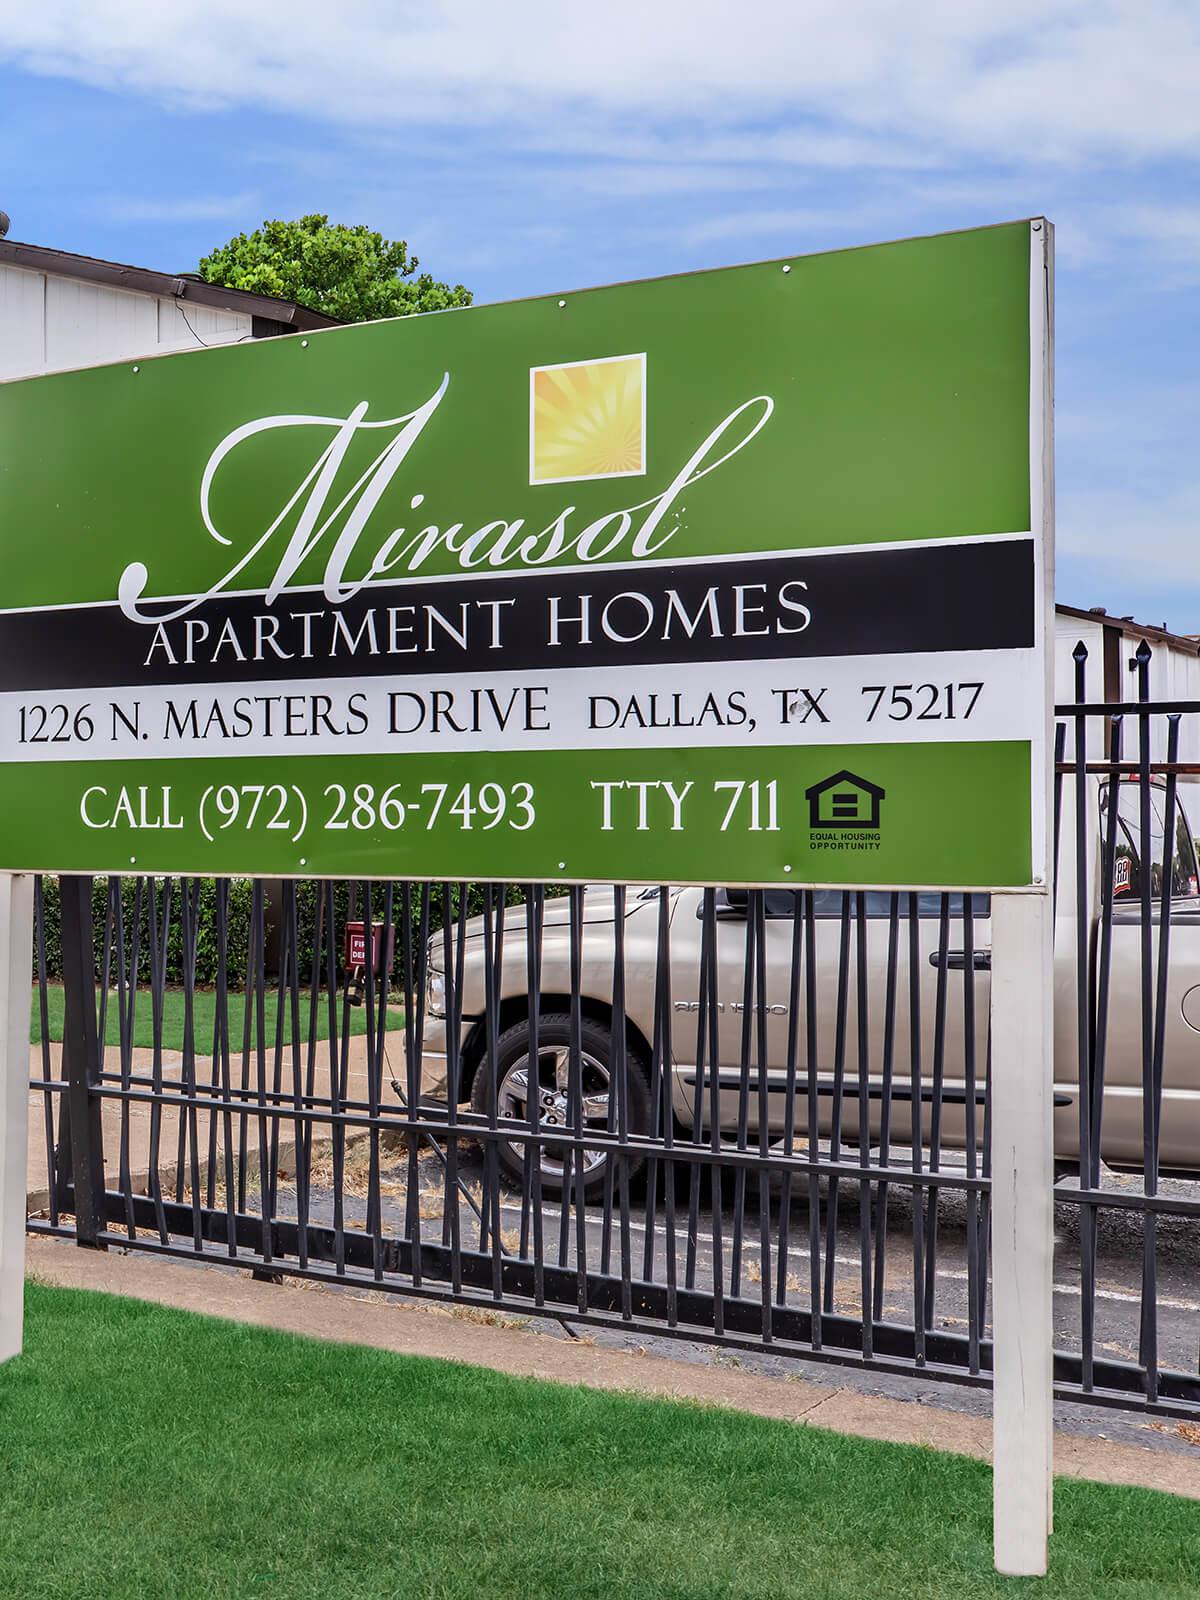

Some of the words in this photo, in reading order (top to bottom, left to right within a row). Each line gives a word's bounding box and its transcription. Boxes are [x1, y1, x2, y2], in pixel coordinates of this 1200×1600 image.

[118, 372, 774, 624] Mirasol
[143, 598, 516, 666] APARTMENT
[547, 580, 812, 646] HOMES
[17, 704, 95, 744] 1226
[110, 701, 149, 741] N.
[162, 693, 368, 740] MASTERS
[388, 687, 550, 735] DRIVE
[587, 691, 757, 733] DALLAS,
[771, 688, 831, 724] TX
[862, 682, 985, 722] 75217
[80, 785, 184, 829] CALL
[199, 784, 308, 842] (972)
[324, 783, 535, 830] 286-7493
[591, 780, 694, 831] TTY
[713, 780, 781, 832] 711
[809, 833, 839, 841] EQUAL
[841, 833, 880, 841] HOUSING
[809, 842, 880, 850] OPPORTUNITY
